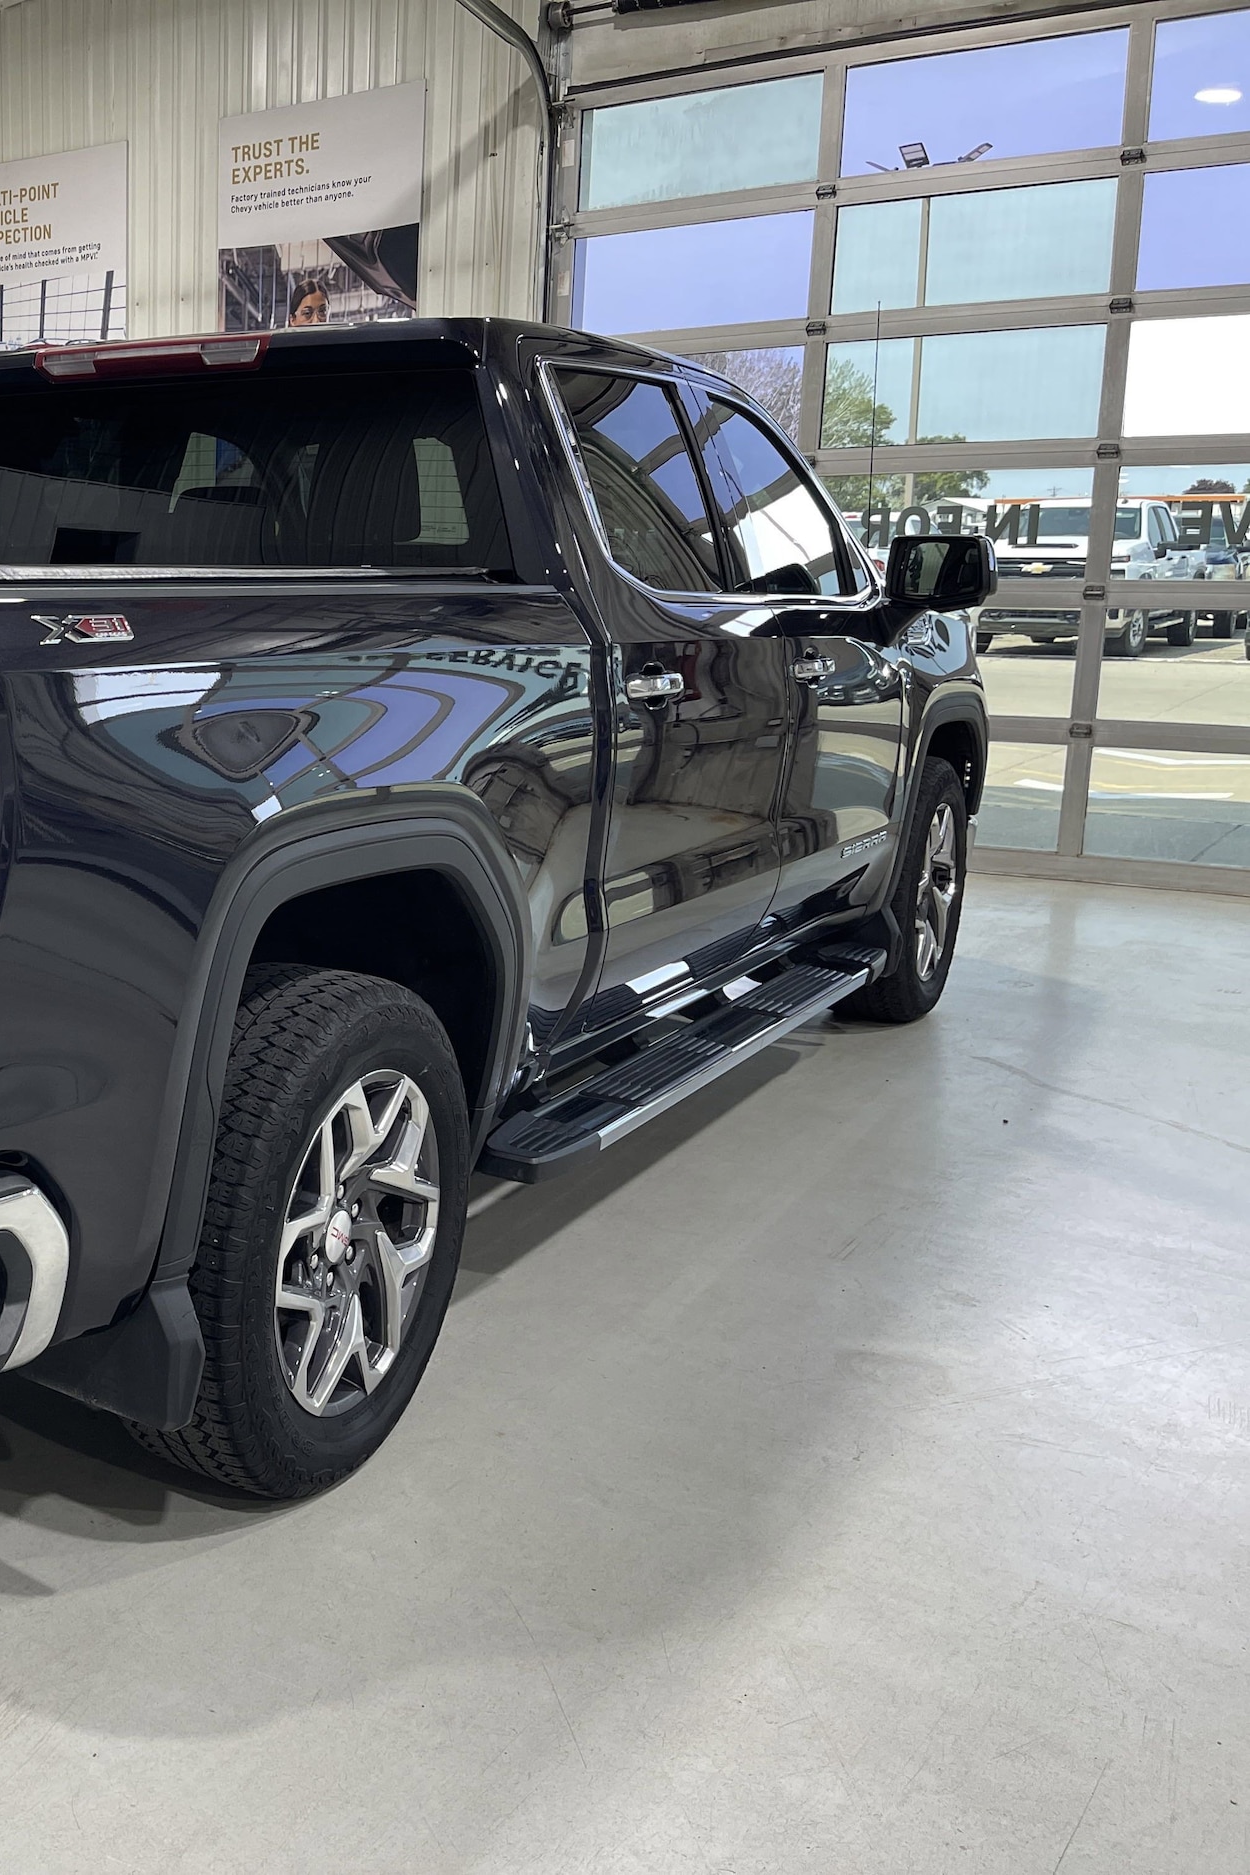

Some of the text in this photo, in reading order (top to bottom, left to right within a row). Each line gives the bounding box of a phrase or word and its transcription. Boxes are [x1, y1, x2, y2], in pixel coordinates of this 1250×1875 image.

[231, 132, 320, 163] TRUST THE
[231, 157, 310, 185] EXPERTS.
[230, 175, 372, 203] Factory trained technicians know your
[230, 190, 354, 214] Chevy vehicle better than anyone.
[4, 253, 11, 261] of
[12, 252, 27, 260] mind
[27, 250, 40, 259] that
[41, 248, 61, 257] comes
[62, 245, 77, 254] from
[78, 242, 101, 253] getting
[15, 261, 34, 270] health
[34, 258, 59, 268] checked
[60, 255, 75, 264] with
[841, 831, 887, 858] SIERRA
[331, 1226, 350, 1247] GMC
